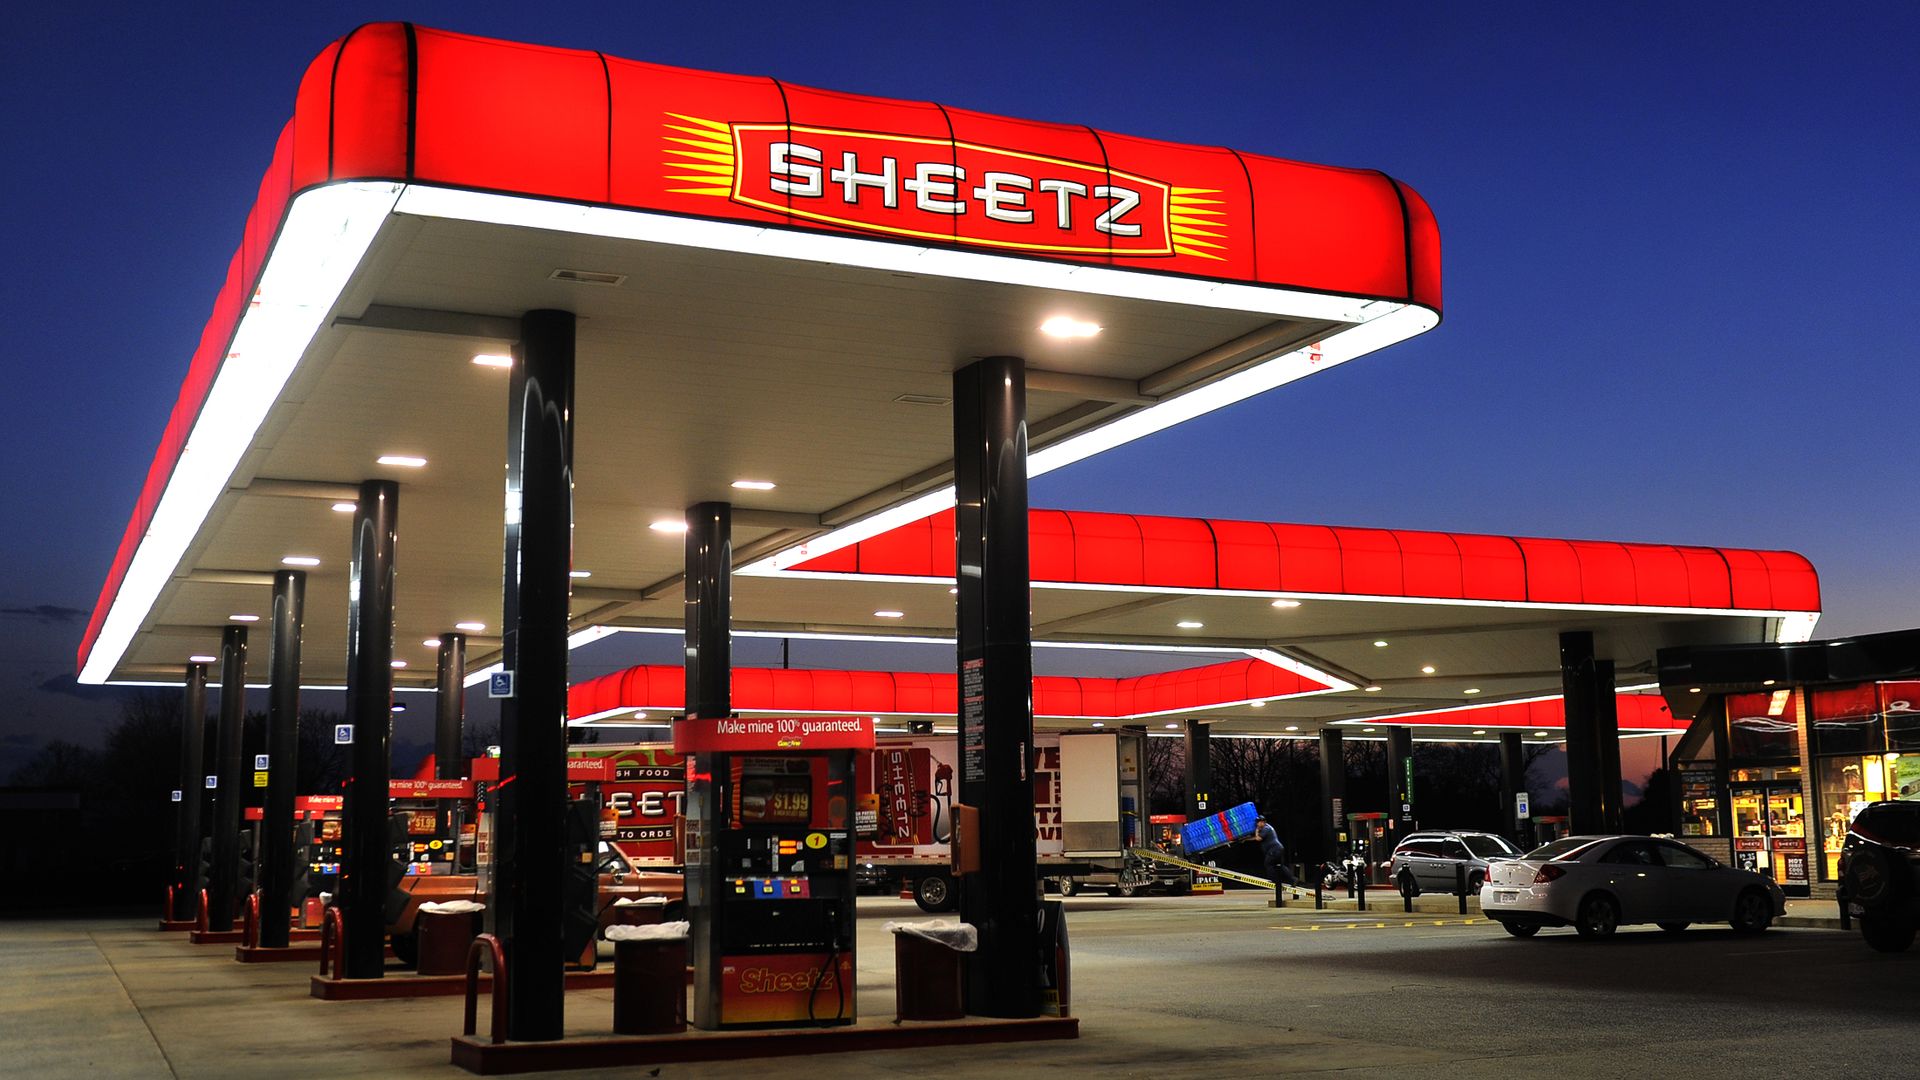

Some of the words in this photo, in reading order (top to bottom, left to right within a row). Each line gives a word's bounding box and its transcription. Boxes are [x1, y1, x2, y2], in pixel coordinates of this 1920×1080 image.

[769, 142, 1142, 237] SHEETZ
[717, 720, 746, 734] Make
[748, 719, 774, 733] mine
[776, 718, 801, 733] 100%
[801, 717, 863, 736] guaranteed.
[639, 769, 670, 777] FOOD
[605, 790, 685, 816] EET
[774, 793, 809, 810] $1.99
[891, 751, 910, 837] SHEETZ
[415, 818, 436, 828] $1.99
[620, 831, 634, 839] TO
[640, 829, 672, 839] ORDE
[813, 835, 820, 847] 1
[740, 967, 833, 993] Sheetz
